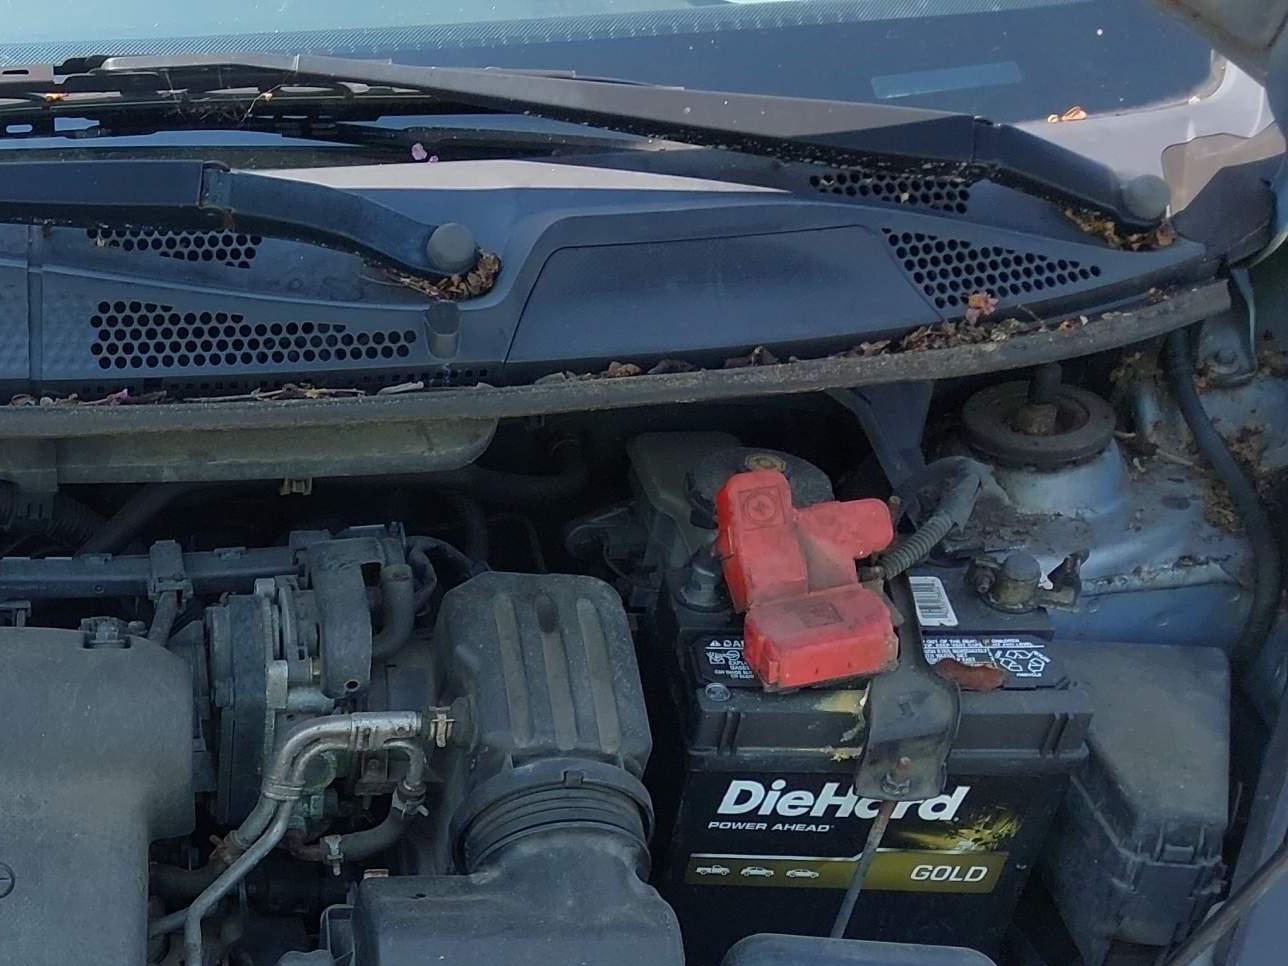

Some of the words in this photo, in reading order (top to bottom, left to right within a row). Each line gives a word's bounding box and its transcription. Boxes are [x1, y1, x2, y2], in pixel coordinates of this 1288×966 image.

[707, 821, 768, 832] POWER
[771, 822, 830, 833] AHEAD
[910, 864, 989, 882] GOLD
